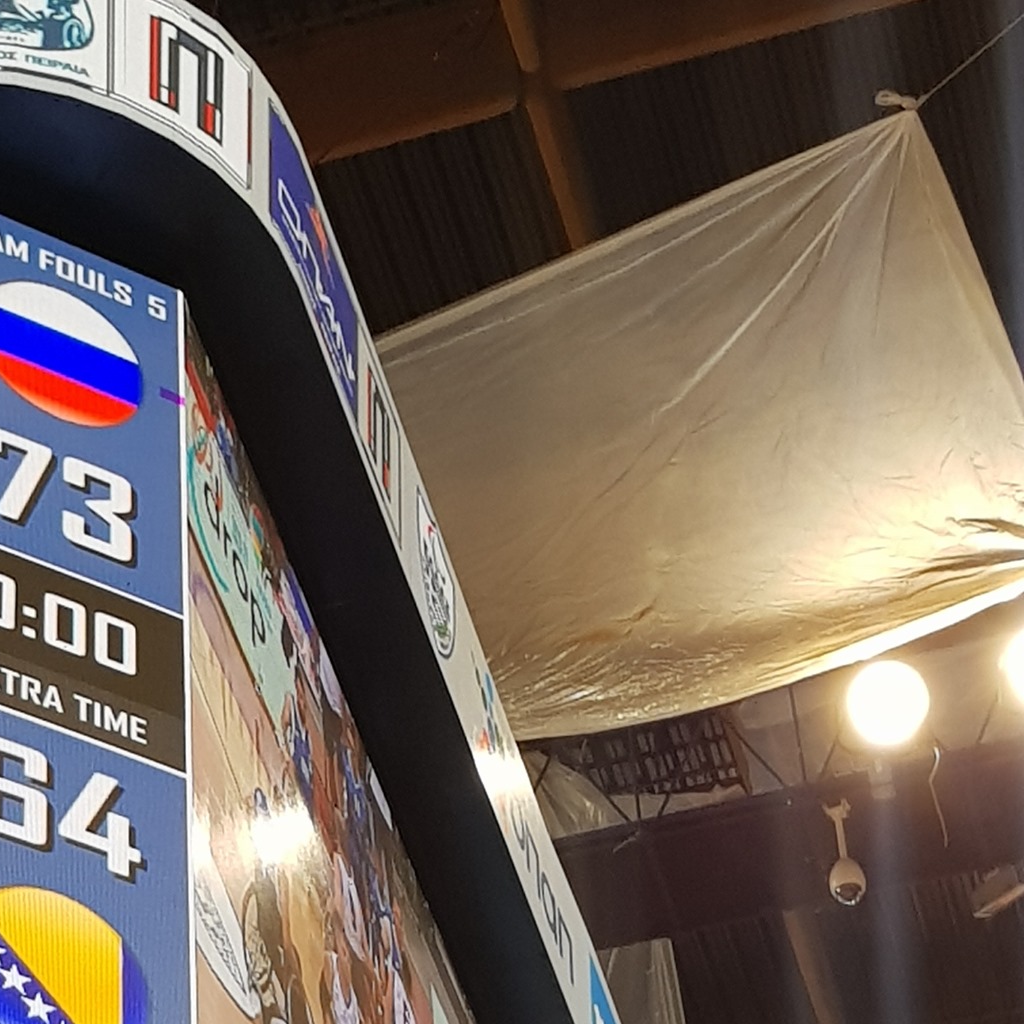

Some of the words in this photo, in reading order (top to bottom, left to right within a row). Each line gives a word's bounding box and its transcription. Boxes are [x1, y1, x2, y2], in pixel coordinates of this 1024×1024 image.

[38, 247, 134, 308] FOULS
[147, 294, 168, 322] 5
[73, 692, 149, 746] TIME
